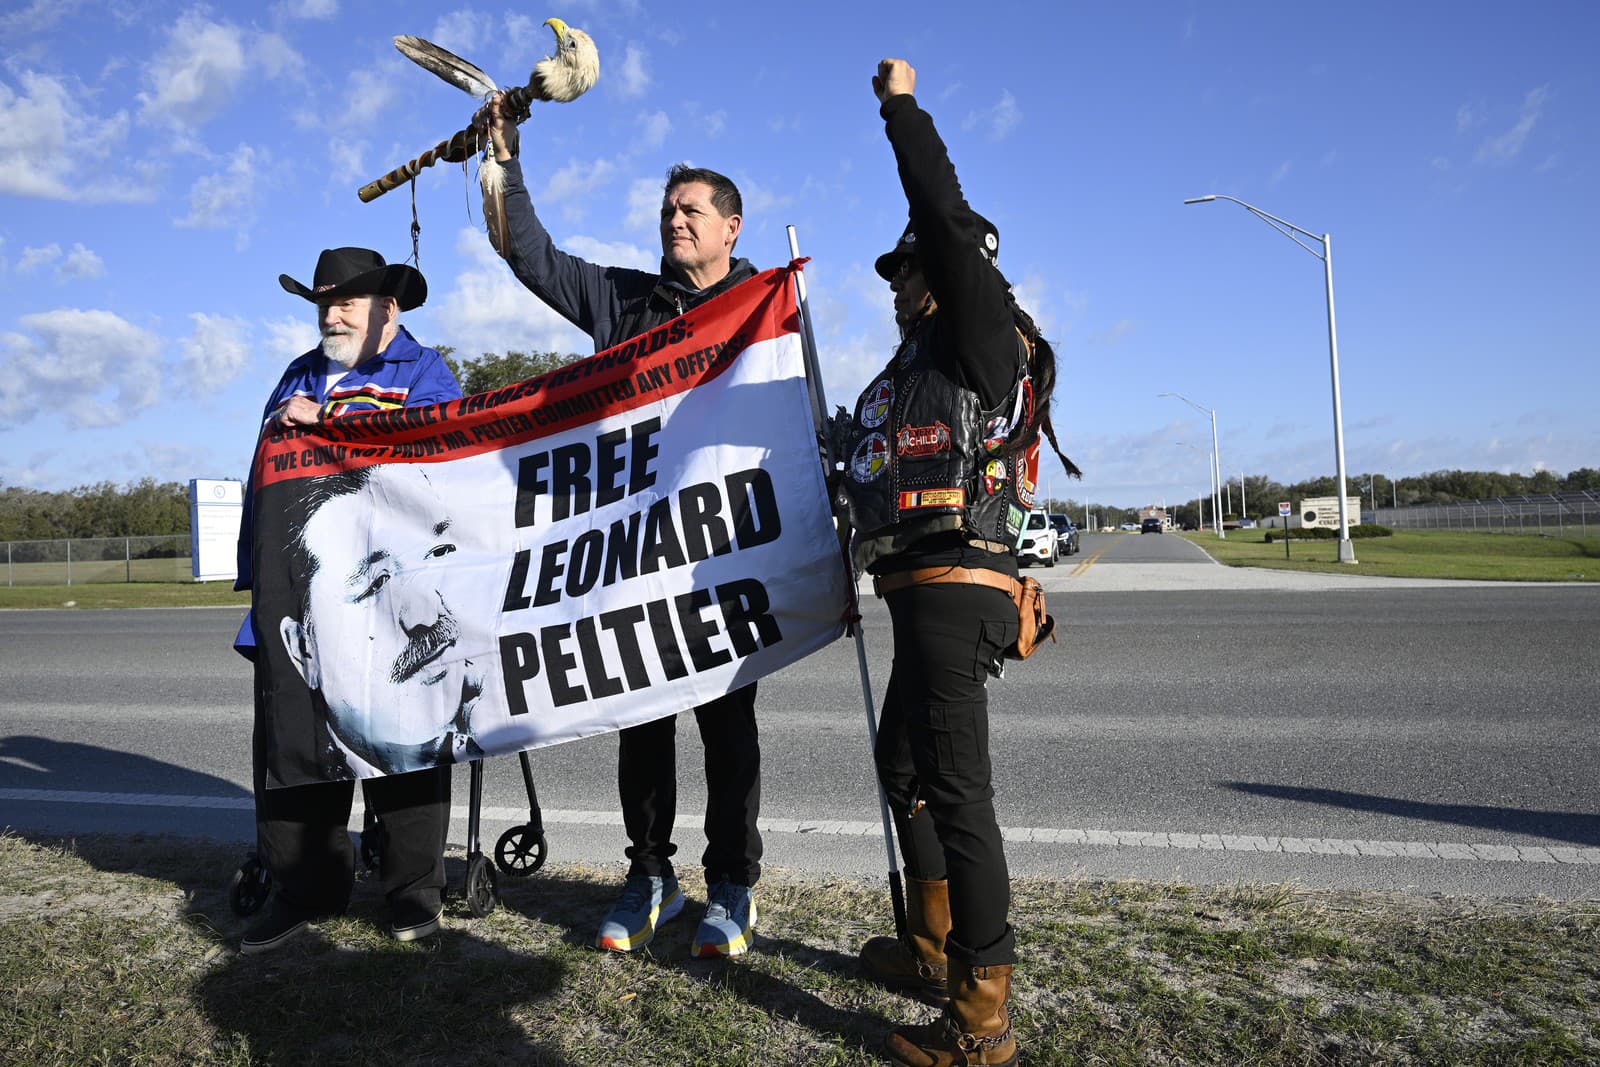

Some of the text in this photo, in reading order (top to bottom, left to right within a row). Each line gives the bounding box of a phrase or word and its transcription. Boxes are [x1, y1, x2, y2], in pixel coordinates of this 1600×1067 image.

[301, 444, 347, 467] COULD
[350, 447, 391, 459] NOT
[390, 433, 443, 459] PROVE
[443, 430, 475, 451] MR.
[470, 413, 533, 443] PELTIER
[531, 374, 636, 428] COMMITTED
[636, 362, 673, 394] ANY
[333, 401, 450, 441] ATTORNEY
[457, 378, 547, 416] JAMES
[547, 319, 695, 388] REYNOLDS:
[515, 416, 661, 528] FREE
[909, 434, 938, 446] CHILD
[502, 468, 781, 612] LEONARD
[499, 578, 782, 716] PELTIER
